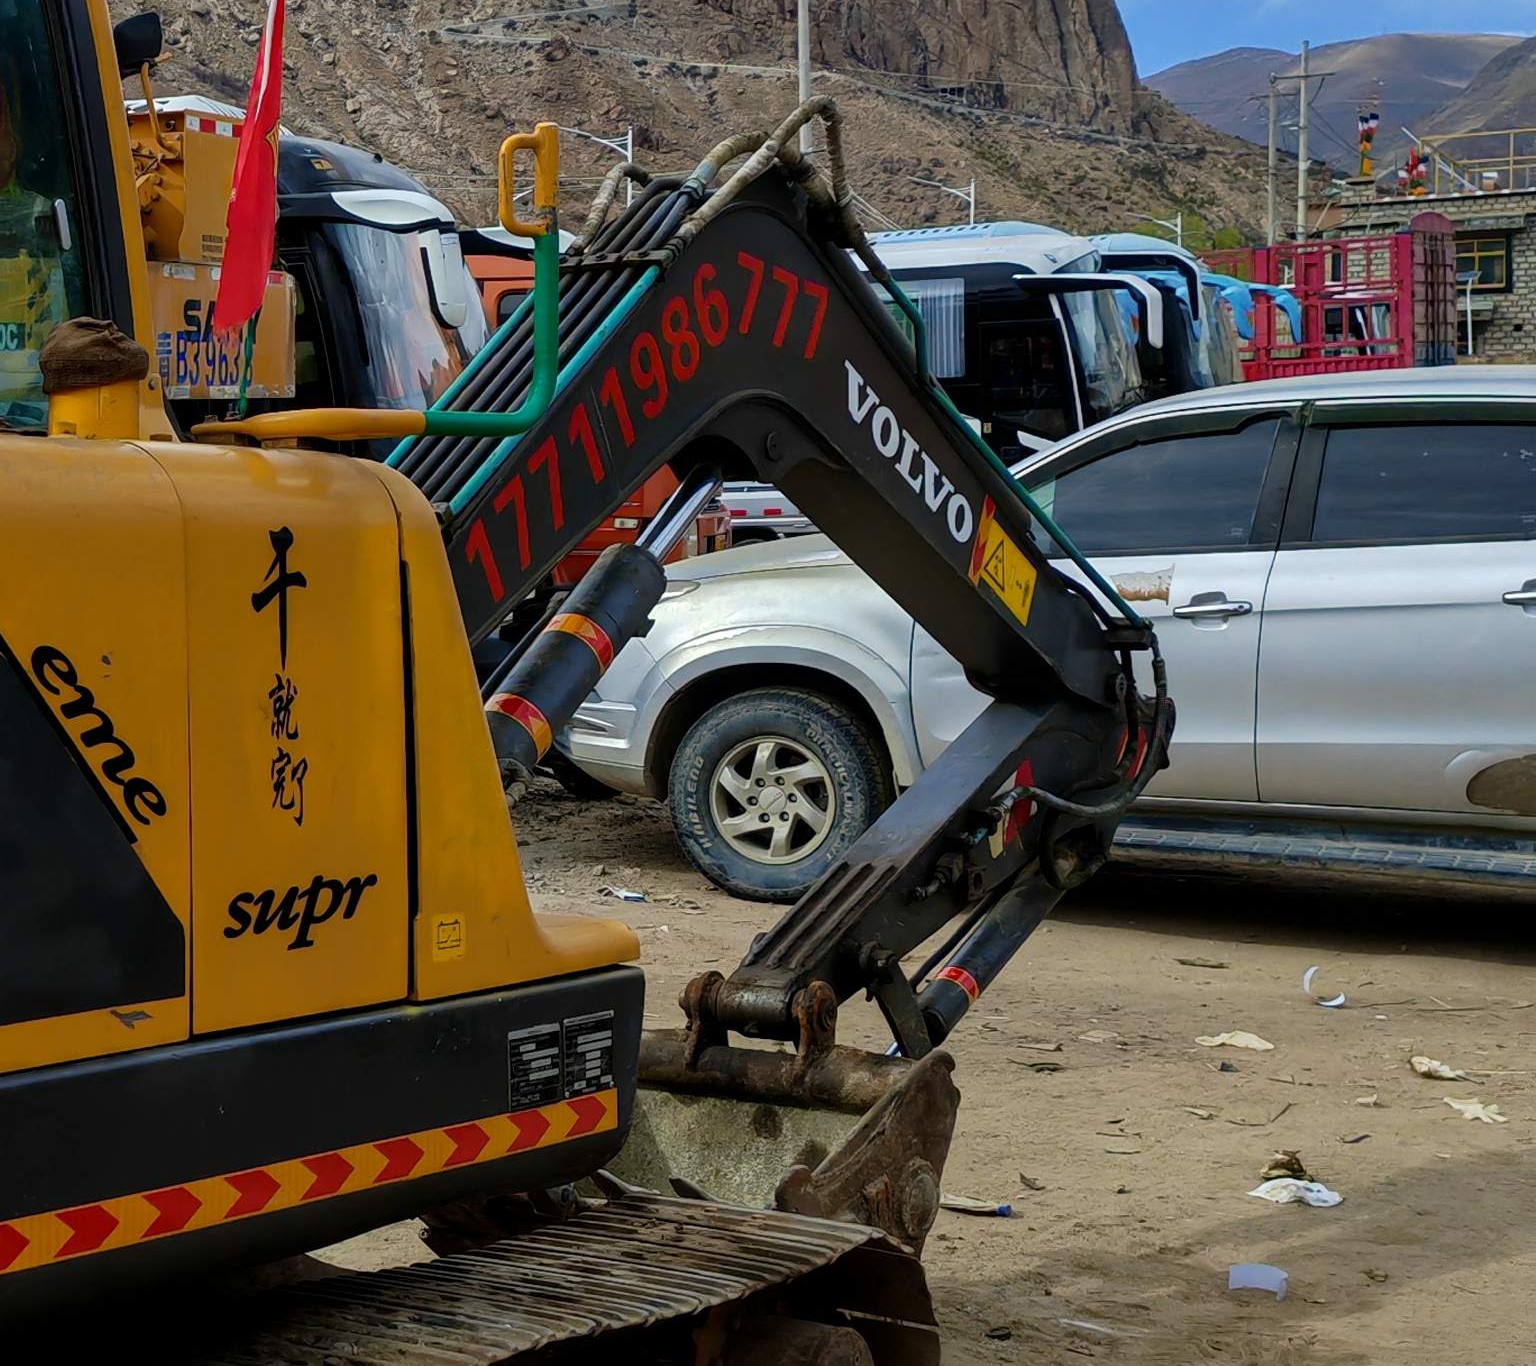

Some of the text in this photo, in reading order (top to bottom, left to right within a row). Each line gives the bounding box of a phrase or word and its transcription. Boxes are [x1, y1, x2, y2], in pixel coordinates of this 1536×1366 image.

[466, 251, 830, 603] 17711986777
[843, 360, 974, 544] VOLVO
[30, 644, 168, 827] eme
[223, 872, 378, 952] supr
